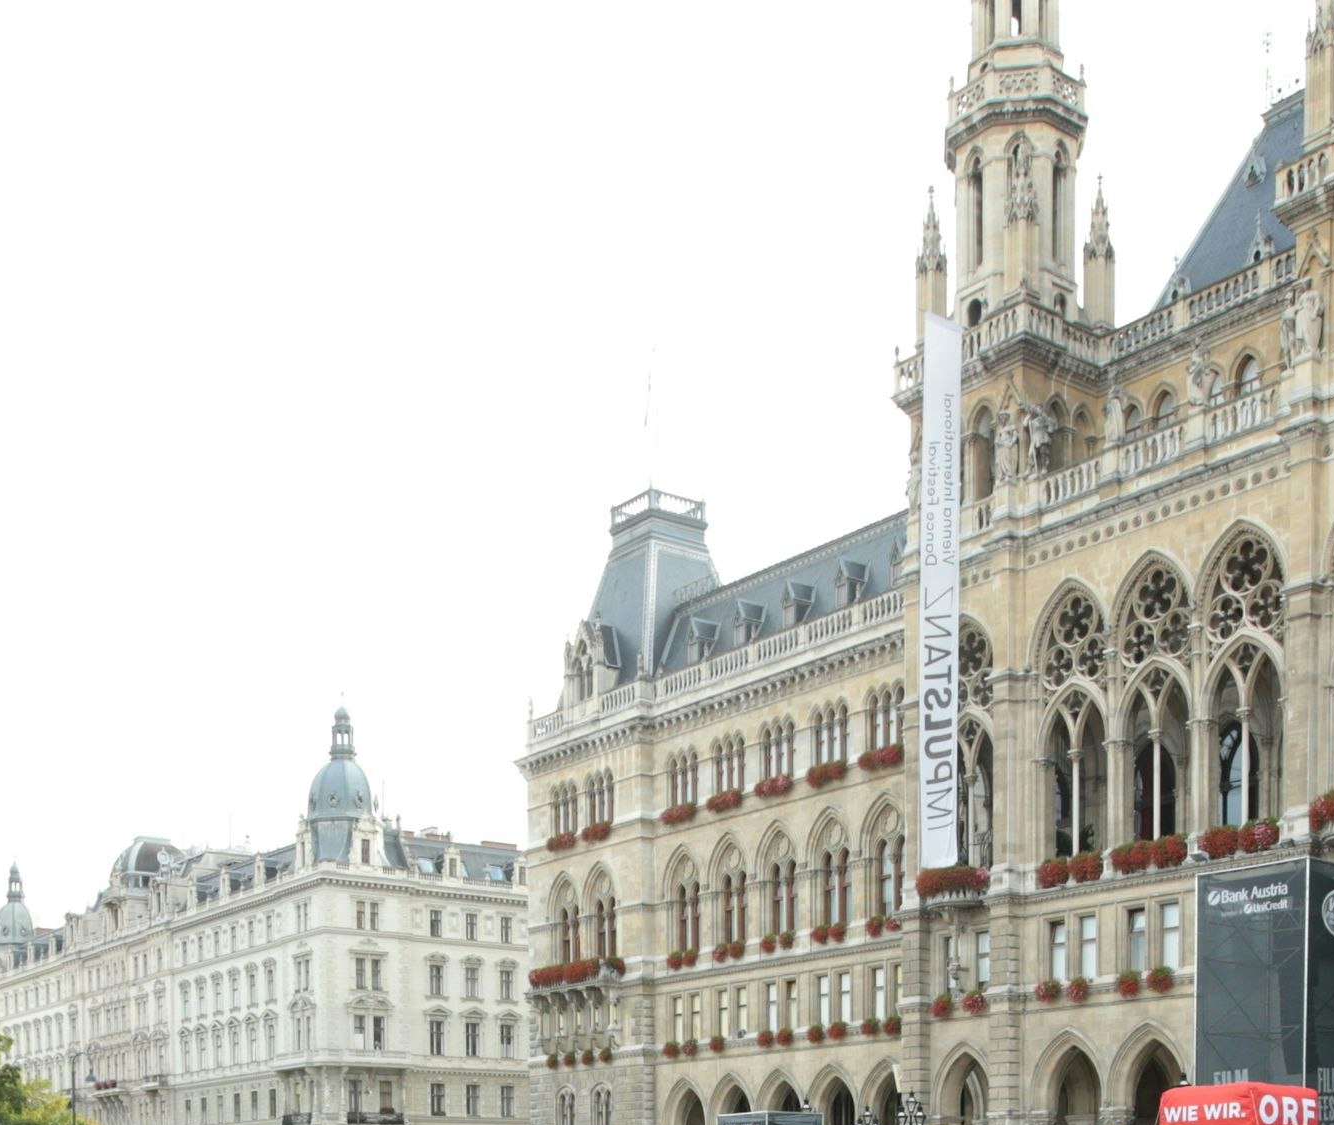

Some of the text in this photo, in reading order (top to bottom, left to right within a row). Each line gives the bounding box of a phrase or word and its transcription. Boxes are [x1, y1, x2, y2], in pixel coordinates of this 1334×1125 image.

[1221, 882, 1288, 904] Bank Austria
[1253, 898, 1288, 913] UniCredit
[1164, 1102, 1246, 1122] WIE WIR.
